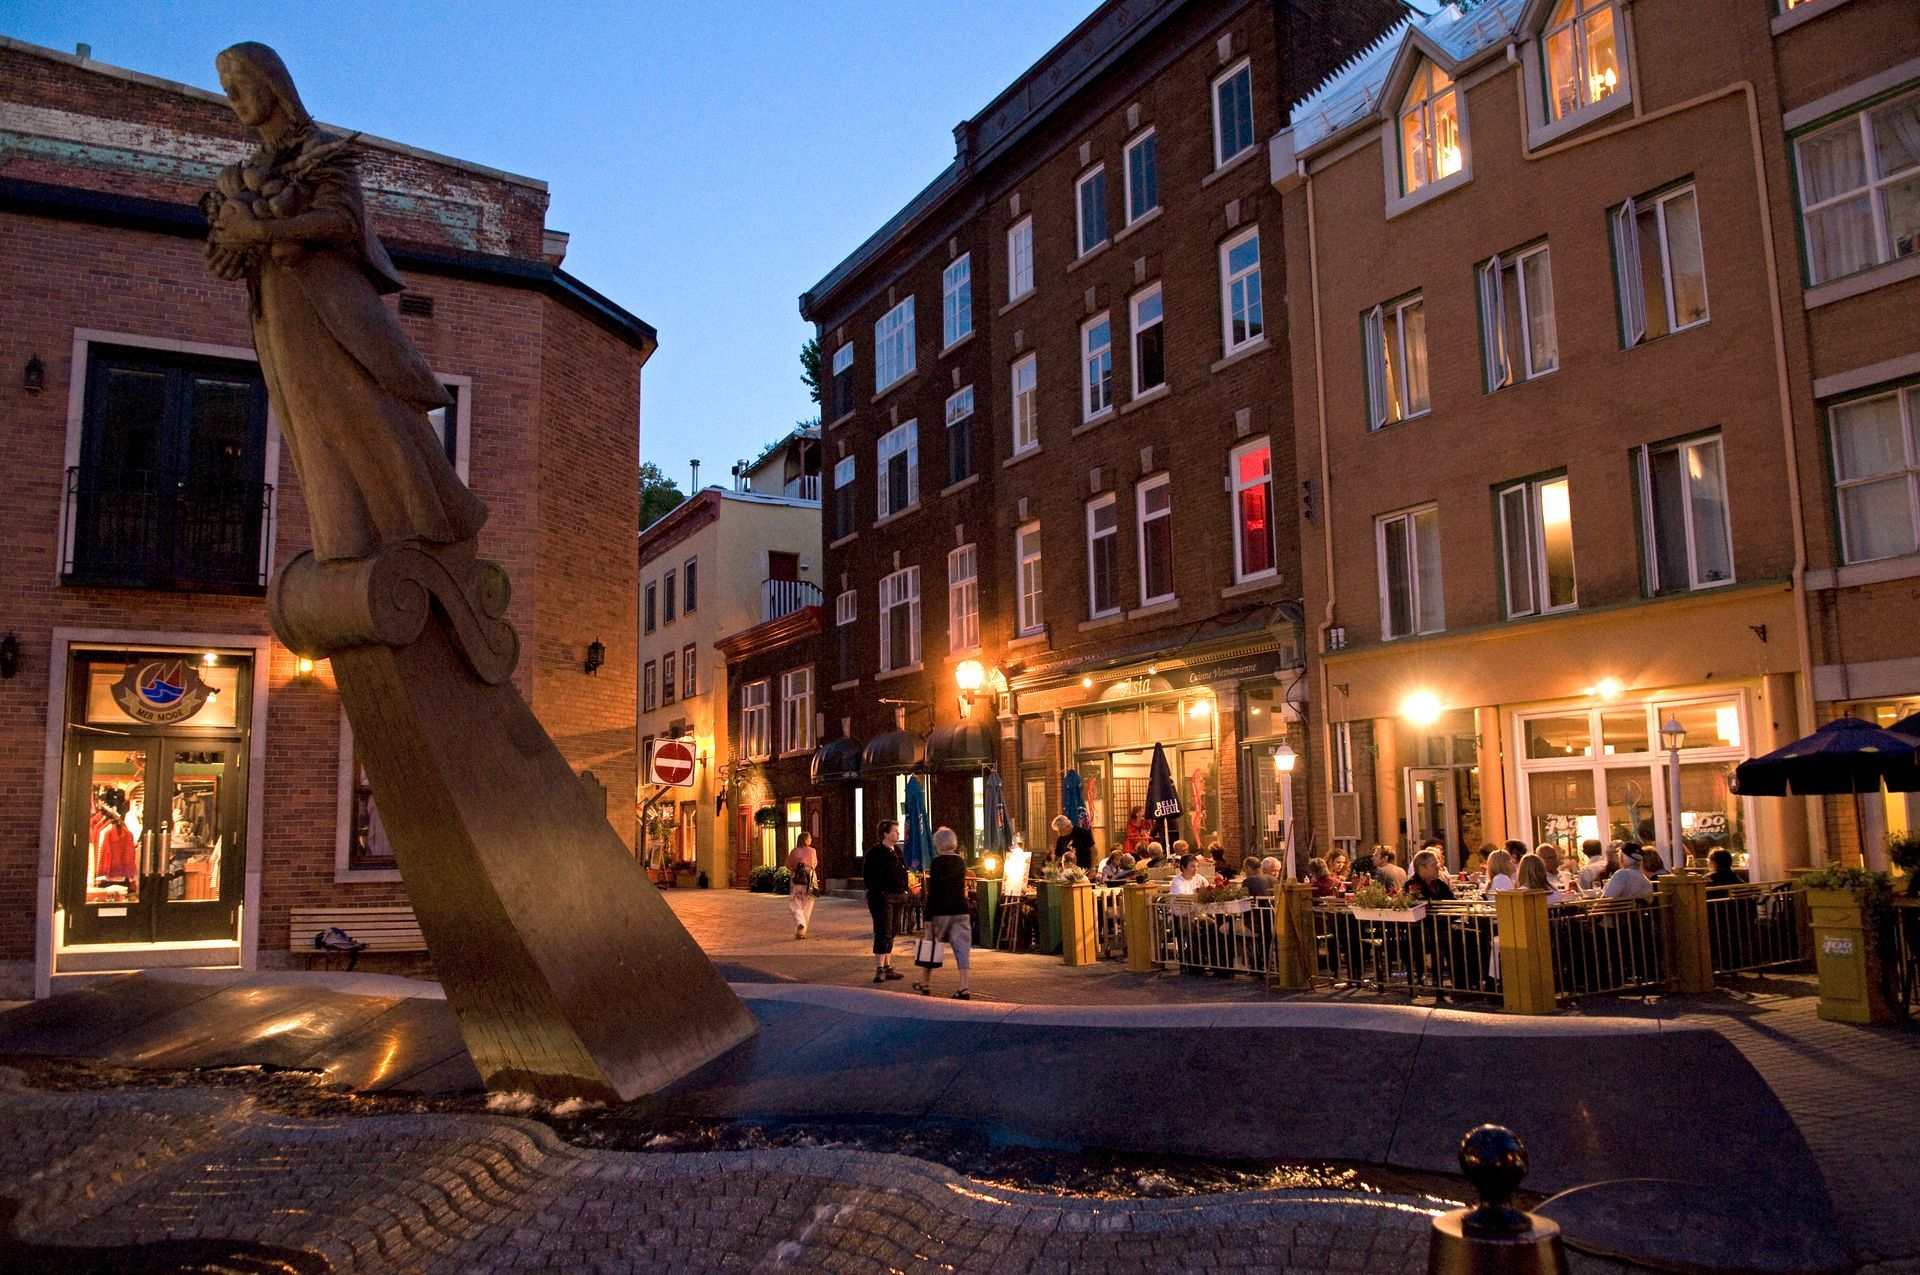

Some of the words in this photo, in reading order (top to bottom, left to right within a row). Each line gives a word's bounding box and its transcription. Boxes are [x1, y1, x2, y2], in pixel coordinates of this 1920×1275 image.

[1189, 670, 1212, 683] Cuisine
[1121, 675, 1151, 697] Asia
[137, 709, 154, 720] MER
[157, 709, 184, 720] MODE
[1155, 806, 1180, 817] GUEUL
